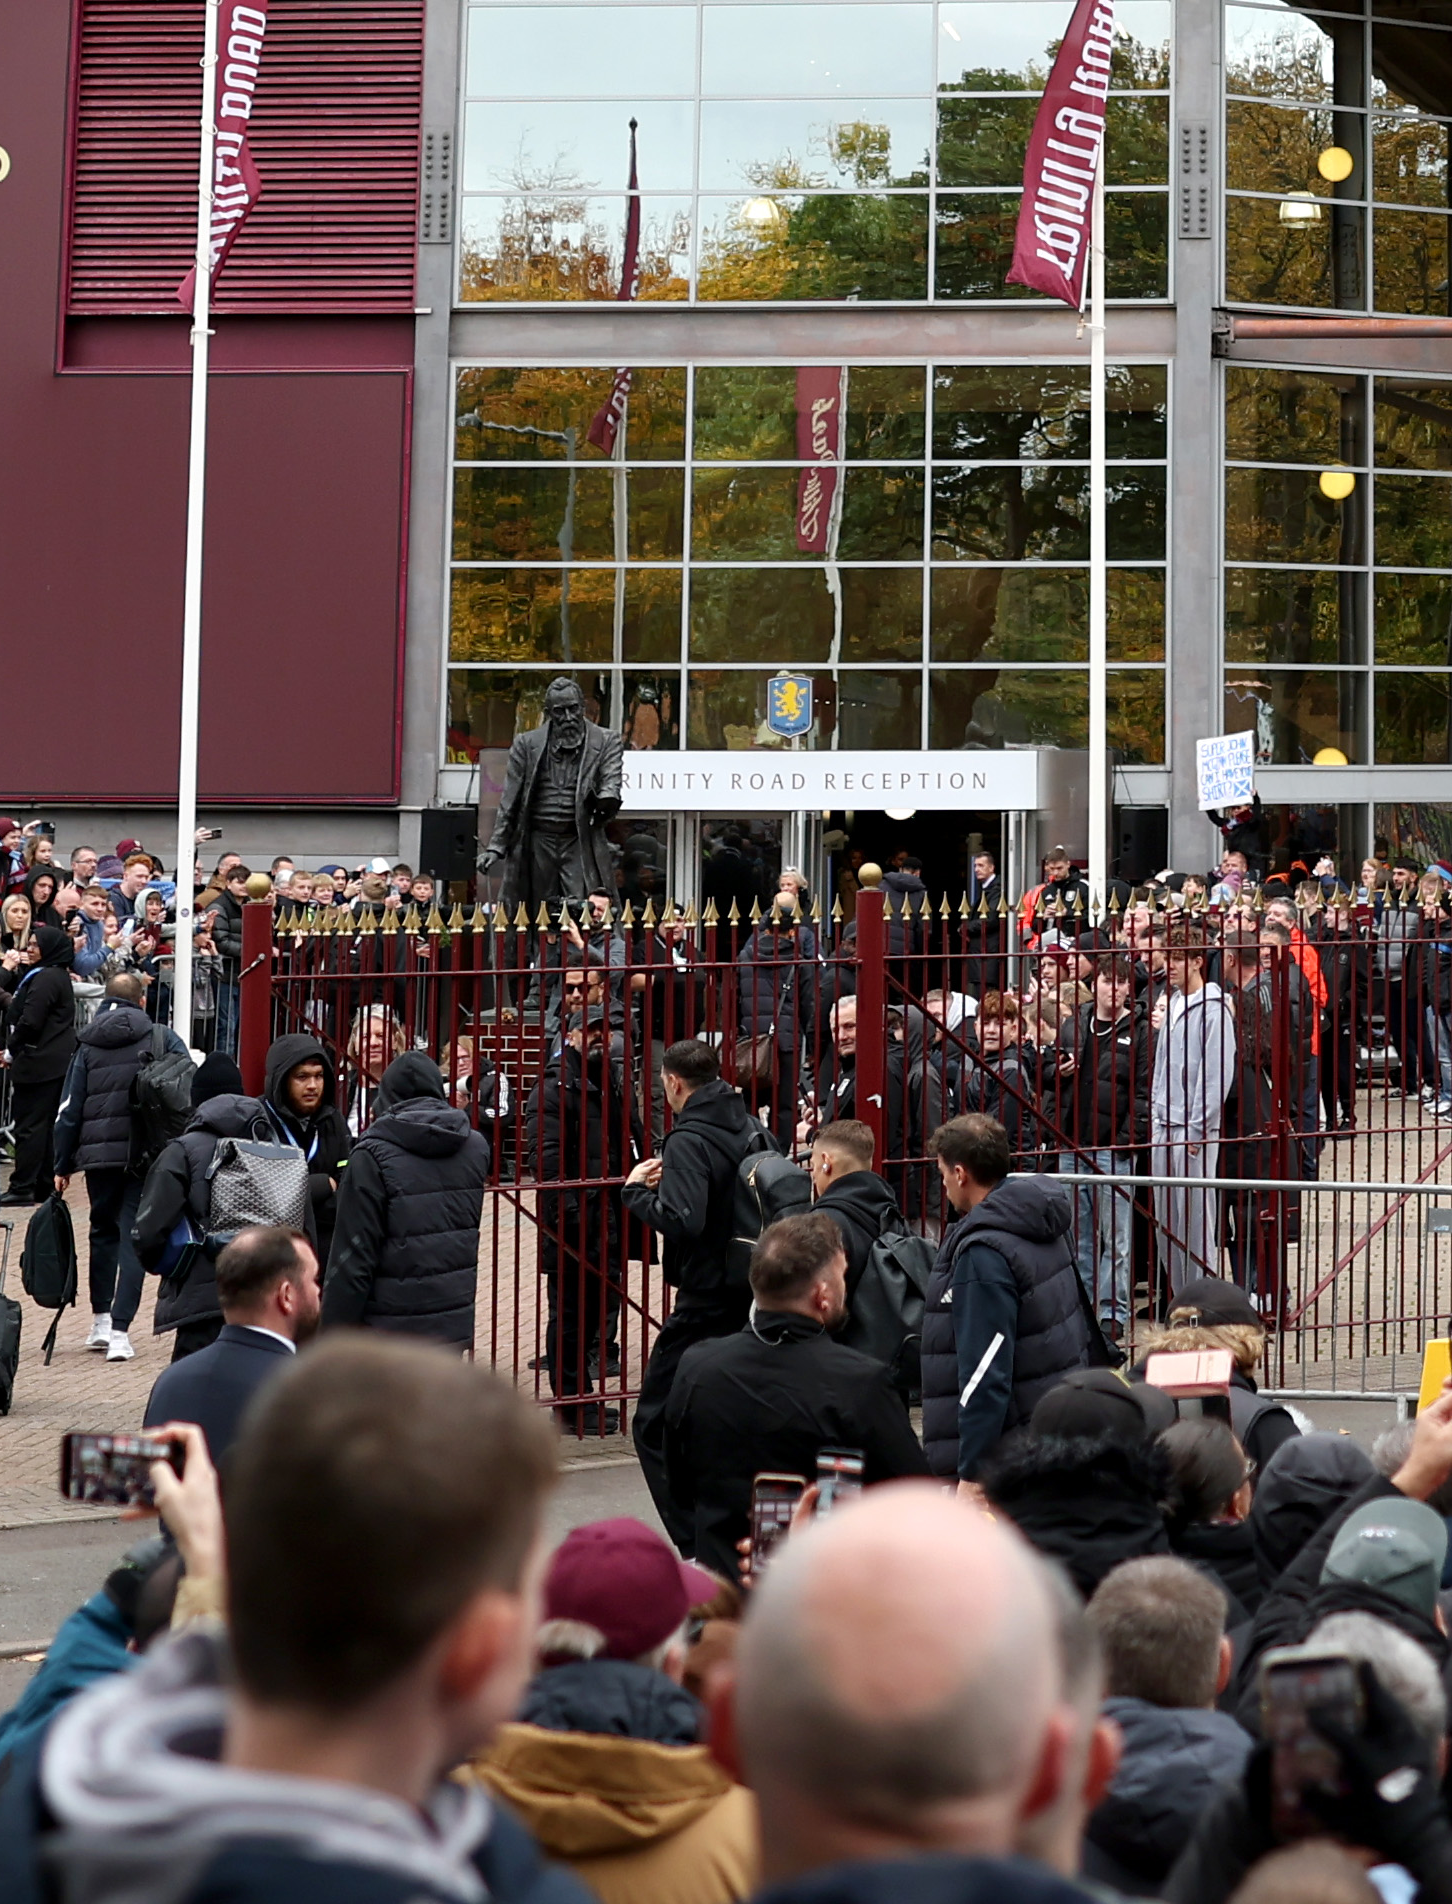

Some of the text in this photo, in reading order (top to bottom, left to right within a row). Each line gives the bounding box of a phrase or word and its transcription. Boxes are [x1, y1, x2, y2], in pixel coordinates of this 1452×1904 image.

[620, 772, 987, 790] RINITY ROAD RECEPTION
